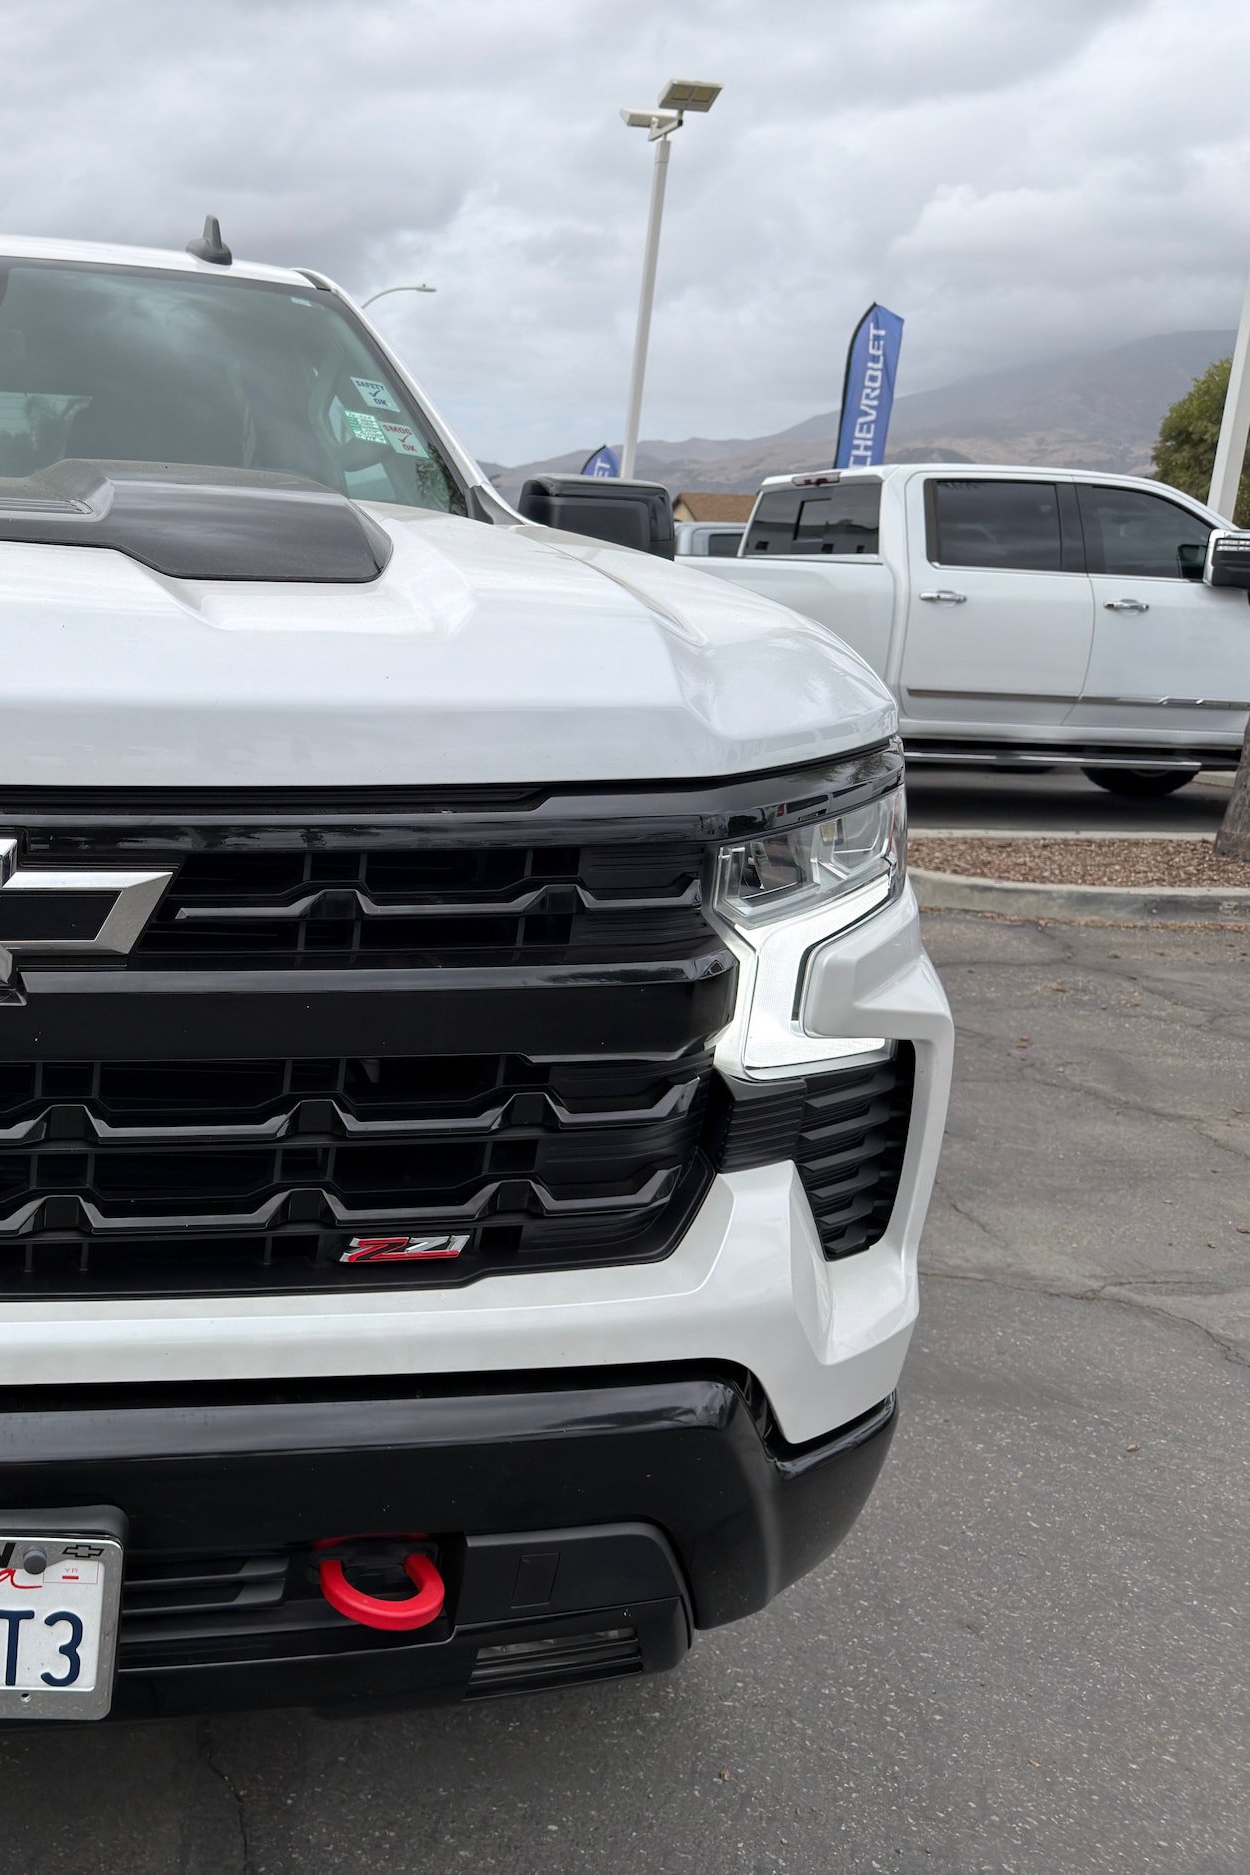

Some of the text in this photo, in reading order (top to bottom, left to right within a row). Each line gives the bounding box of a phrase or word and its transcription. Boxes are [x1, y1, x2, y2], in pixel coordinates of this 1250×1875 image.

[355, 380, 385, 391] SAFETY
[849, 323, 886, 469] CHEVROLET
[373, 398, 390, 407] OK
[382, 424, 413, 435] SMOG
[402, 443, 418, 453] OK
[339, 1235, 470, 1263] Z71
